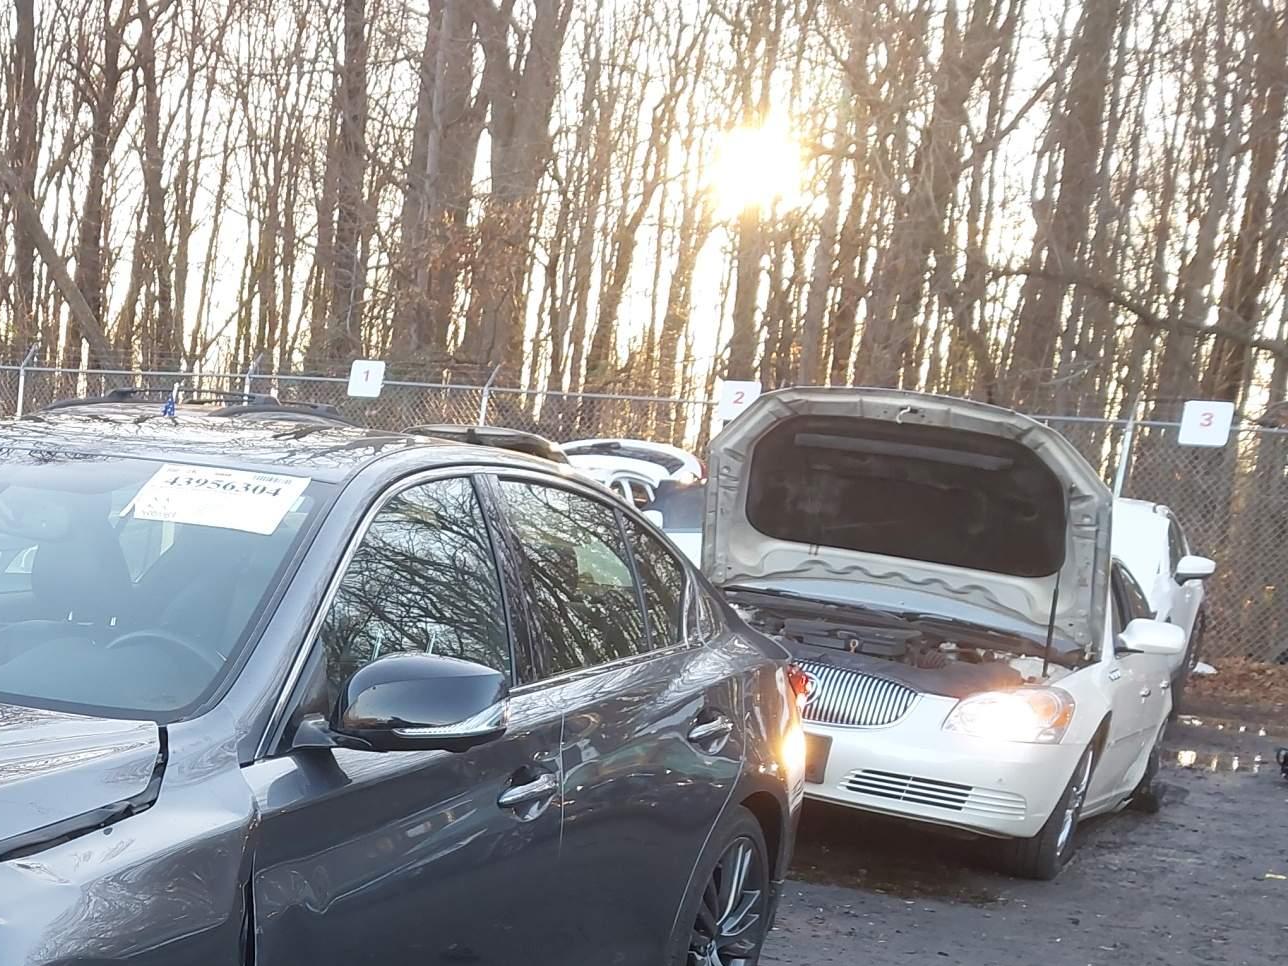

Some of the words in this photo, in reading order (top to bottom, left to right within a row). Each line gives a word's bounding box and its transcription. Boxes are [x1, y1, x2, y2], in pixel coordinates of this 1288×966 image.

[363, 369, 370, 382] 1
[733, 391, 745, 404] 2
[1200, 412, 1214, 427] 3
[165, 475, 283, 497] 43956304
